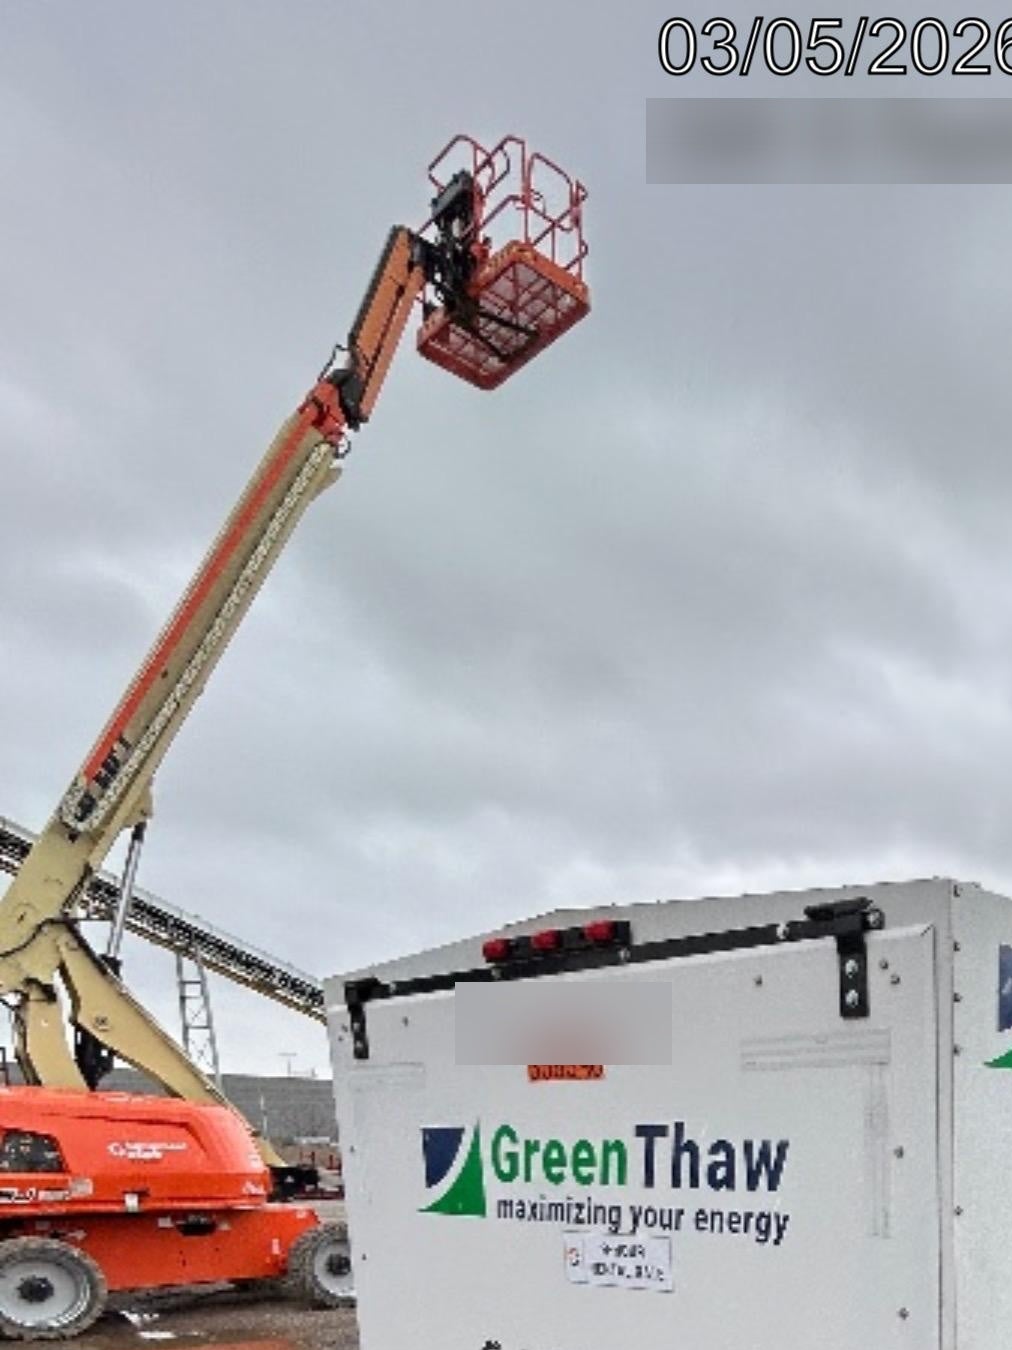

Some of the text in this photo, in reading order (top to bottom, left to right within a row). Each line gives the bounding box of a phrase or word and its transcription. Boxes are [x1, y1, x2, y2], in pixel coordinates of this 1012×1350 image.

[497, 1194, 790, 1246] maximizing your energy
